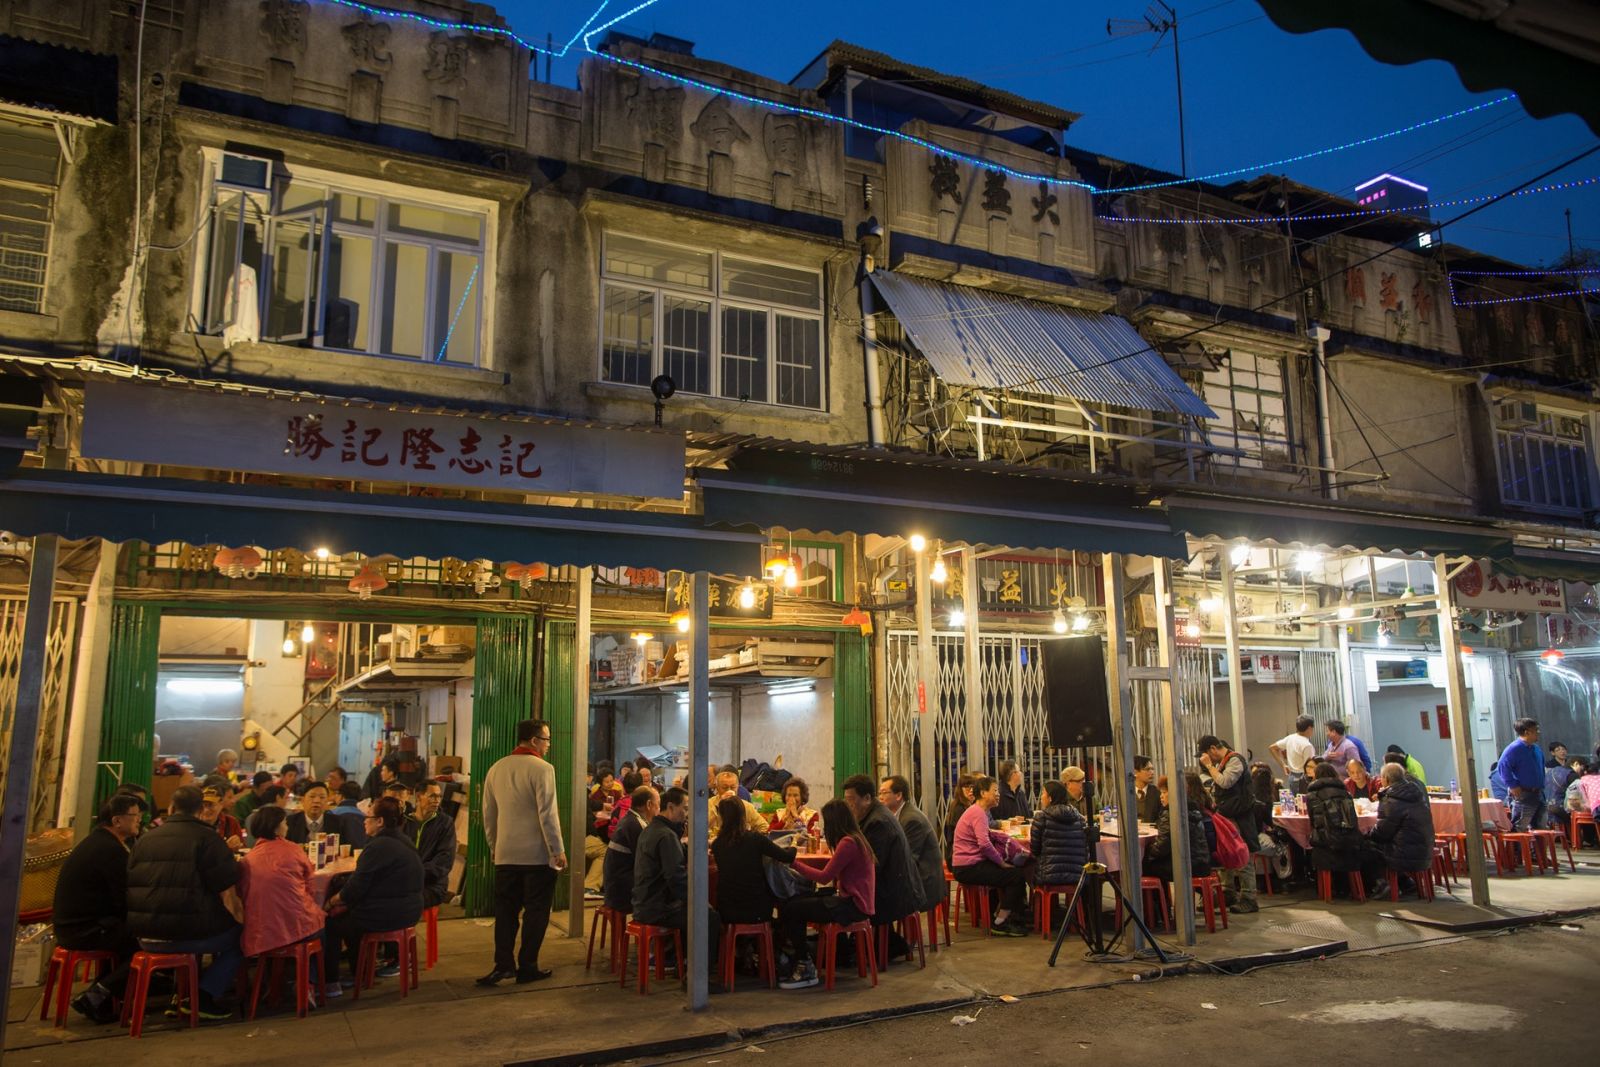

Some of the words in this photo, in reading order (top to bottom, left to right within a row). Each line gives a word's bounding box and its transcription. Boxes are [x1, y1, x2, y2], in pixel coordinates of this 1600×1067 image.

[286, 414, 543, 479] 勝記隆志記
